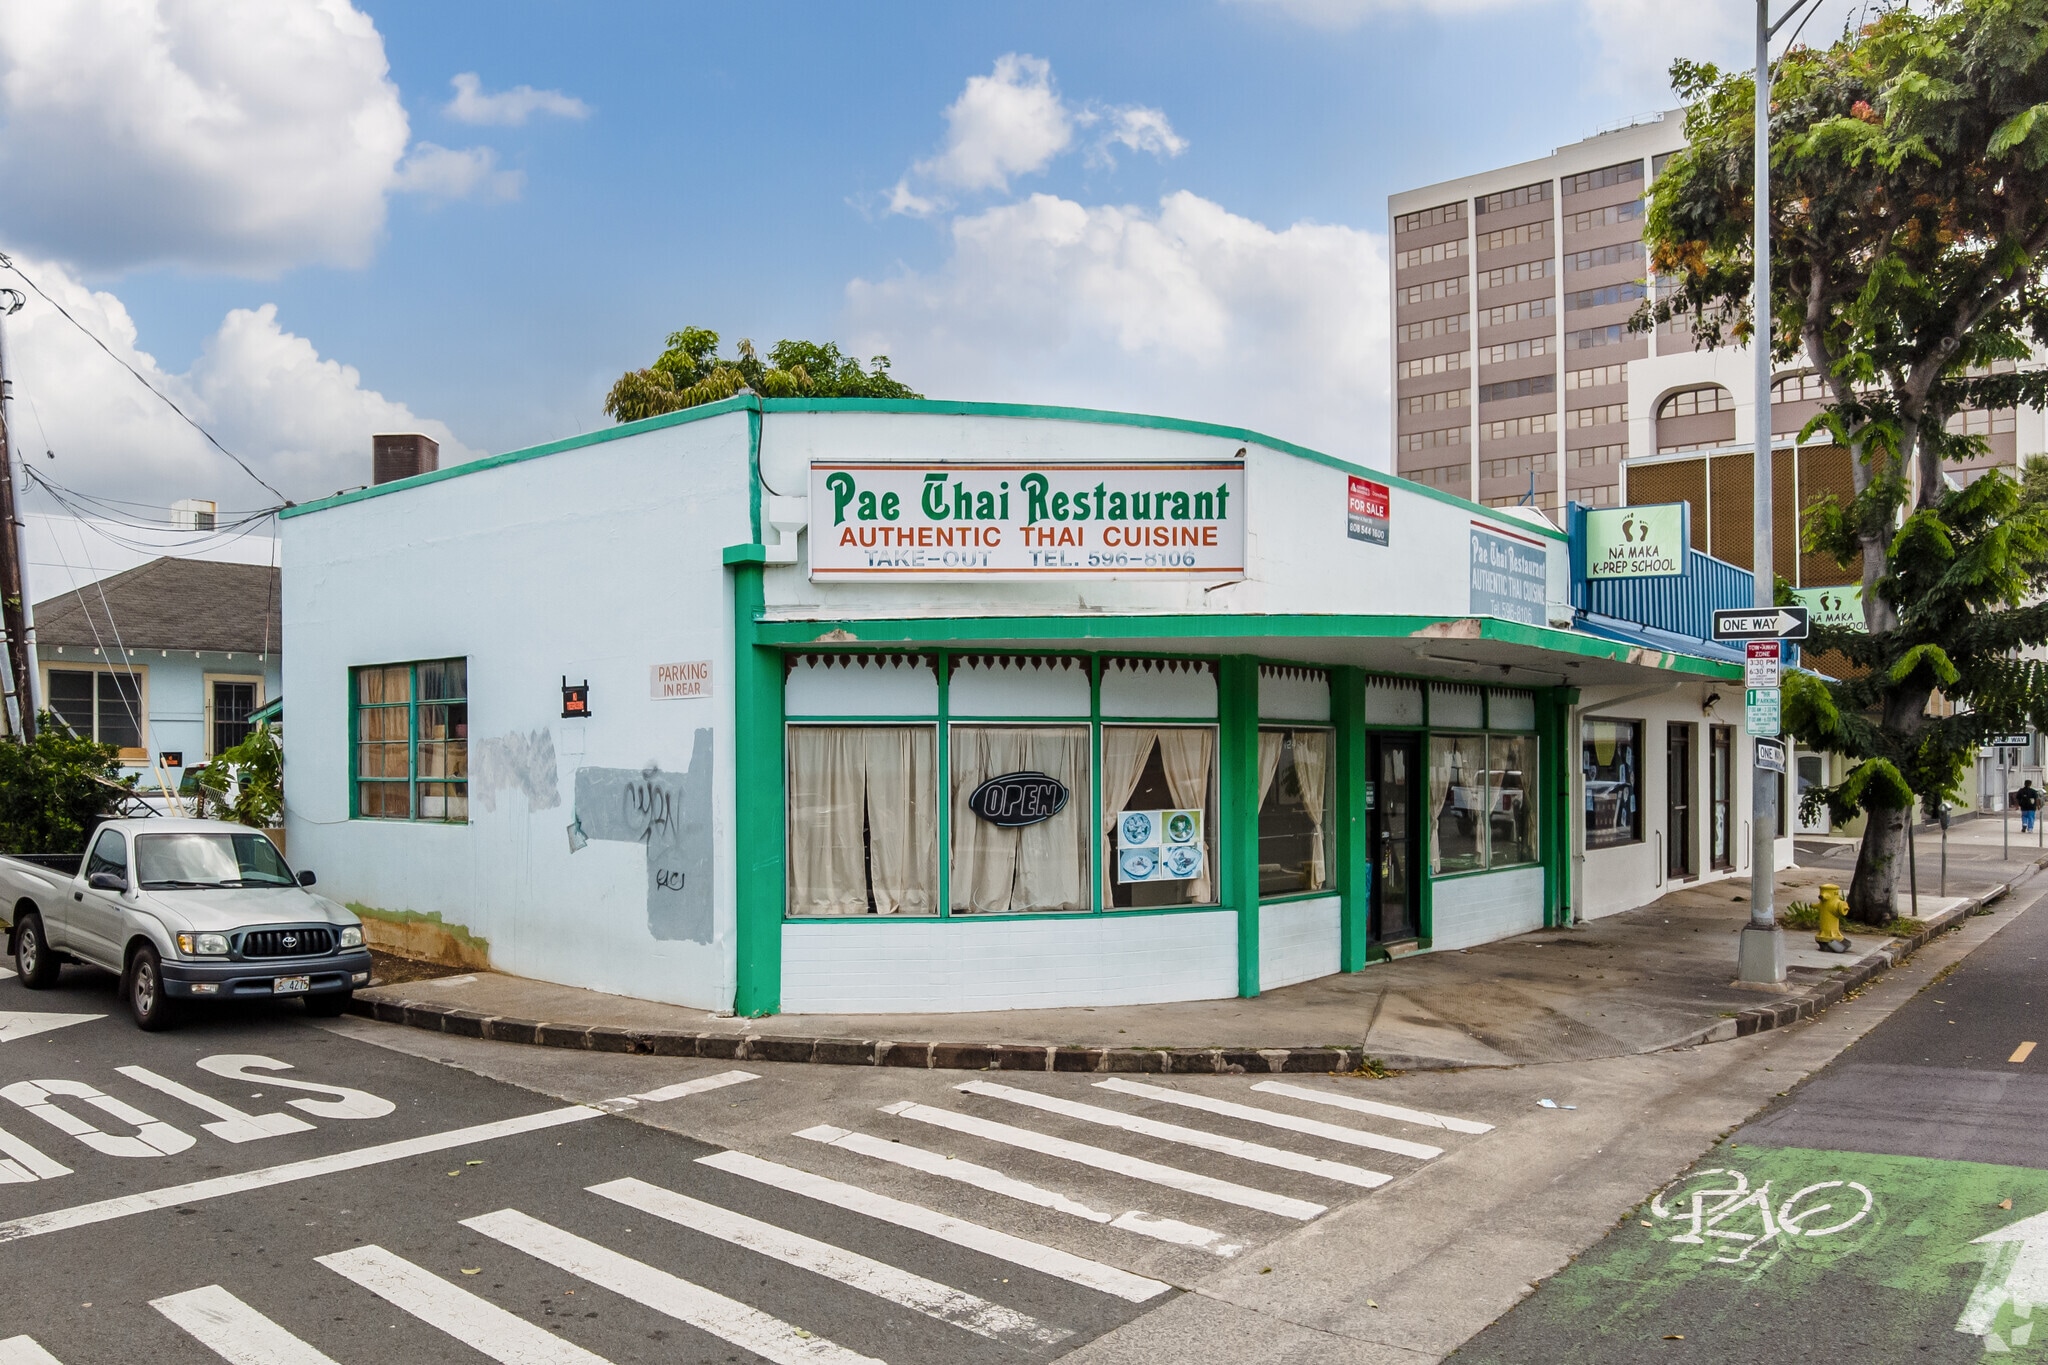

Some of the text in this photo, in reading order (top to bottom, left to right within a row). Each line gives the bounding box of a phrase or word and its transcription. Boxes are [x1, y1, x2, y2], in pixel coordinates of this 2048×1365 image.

[826, 471, 1230, 527] Pae Thai Restaurant
[1350, 498, 1384, 517] FOR SALE
[839, 526, 1218, 548] AUTHENTIC THAI CUISINE
[864, 549, 1196, 568] TAKE-OUT TEL. 596-8106
[1472, 535, 1546, 580] Pae Thai Restaurant
[1628, 545, 1659, 559] MAKA
[1592, 559, 1676, 575] K-PREP SCHOOL
[1472, 567, 1546, 605] AUTHENTIC THAI CUISINE
[1723, 617, 1778, 631] ONE WAY
[1826, 613, 1854, 623] MAKA
[658, 663, 708, 682] PARKING
[663, 682, 701, 697] IN REAR
[1761, 746, 1773, 760] ONE
[984, 784, 1057, 817] OPEN
